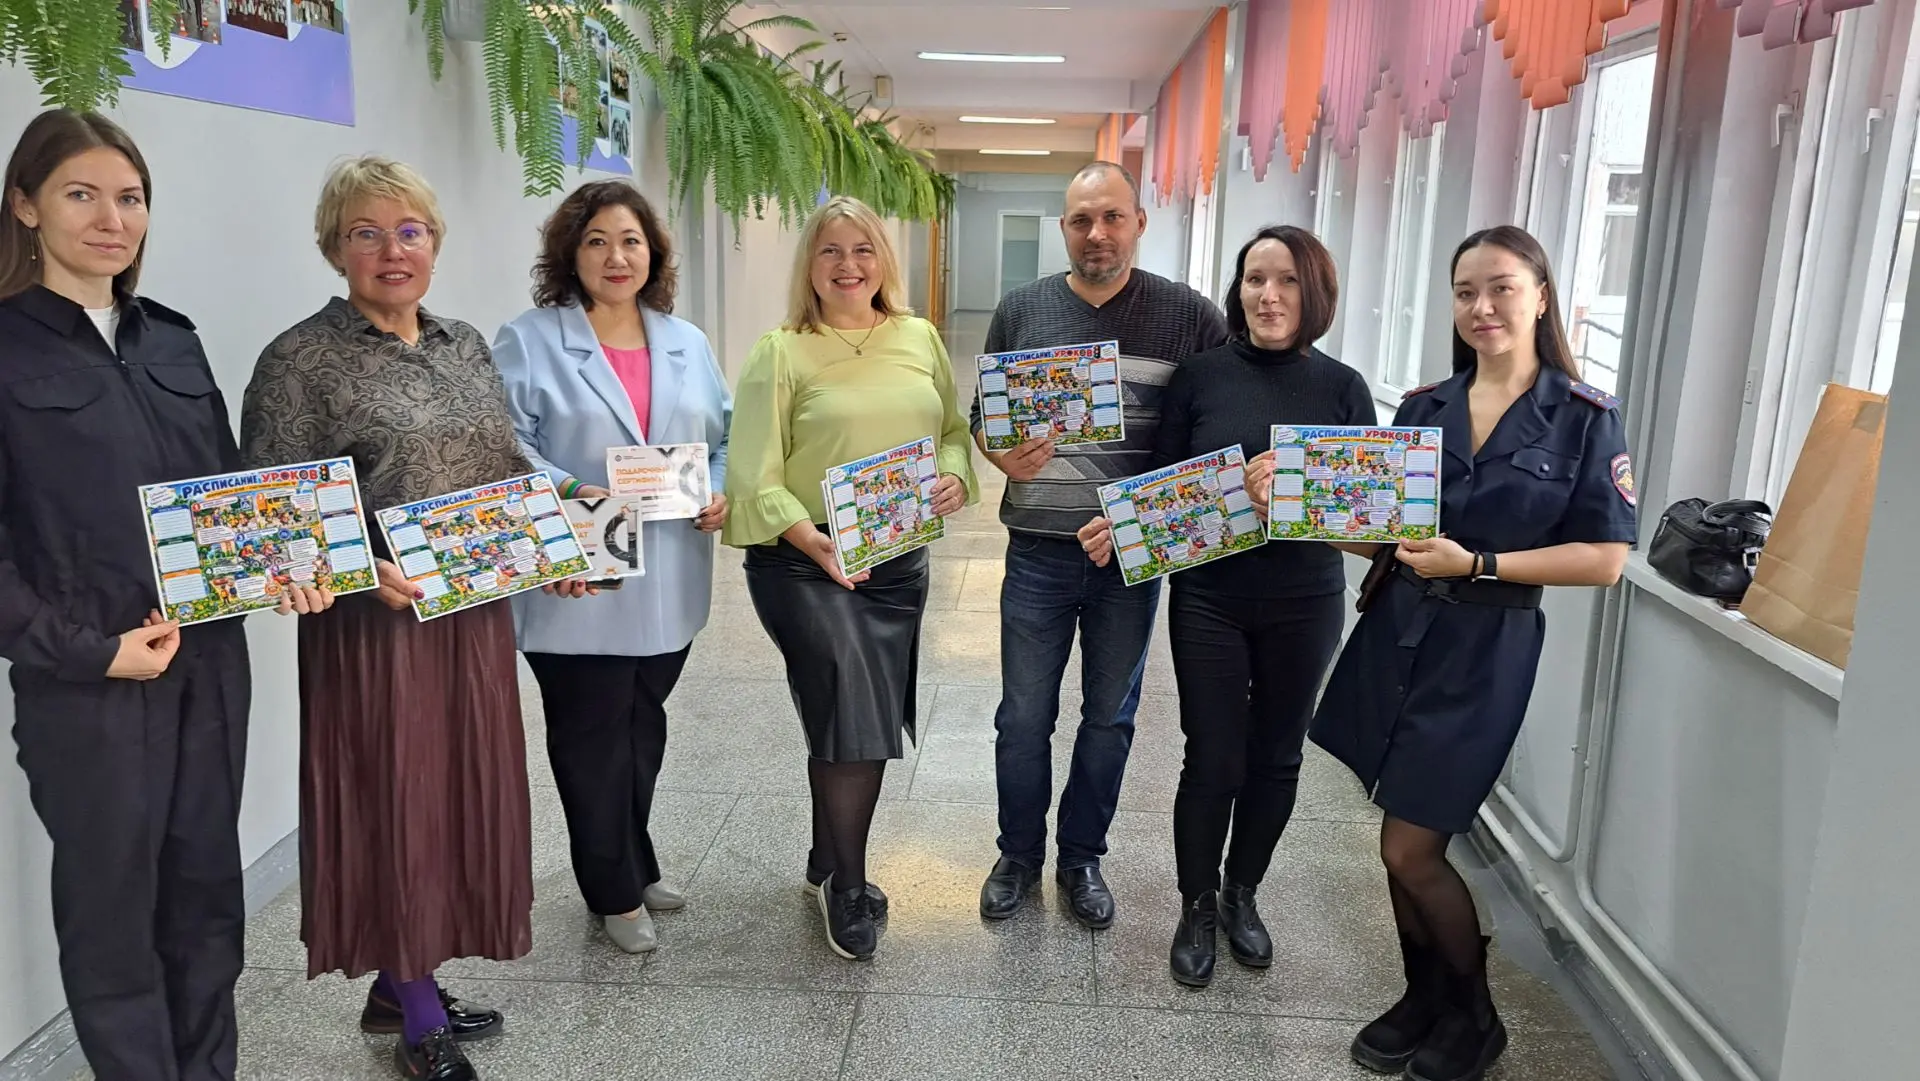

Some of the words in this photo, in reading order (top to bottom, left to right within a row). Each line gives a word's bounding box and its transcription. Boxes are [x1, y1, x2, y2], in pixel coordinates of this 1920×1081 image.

[1002, 351, 1052, 366] РАСПИСАНИЕ
[1054, 349, 1093, 358] УРОКОВ
[1302, 429, 1361, 440] РАСПИСАНИЕ
[1364, 430, 1411, 442] УРОКОВ
[889, 447, 917, 460] УРОКОВ
[182, 475, 258, 498] РАСПИСАНИЕ
[261, 469, 319, 483] УРОКОВ
[1125, 468, 1175, 492] РАСПИСАНИЕ
[1177, 458, 1218, 473] УРОКОВ
[411, 492, 474, 516] РАСПИСАНИЕ
[475, 484, 524, 500] УРОКОВ
